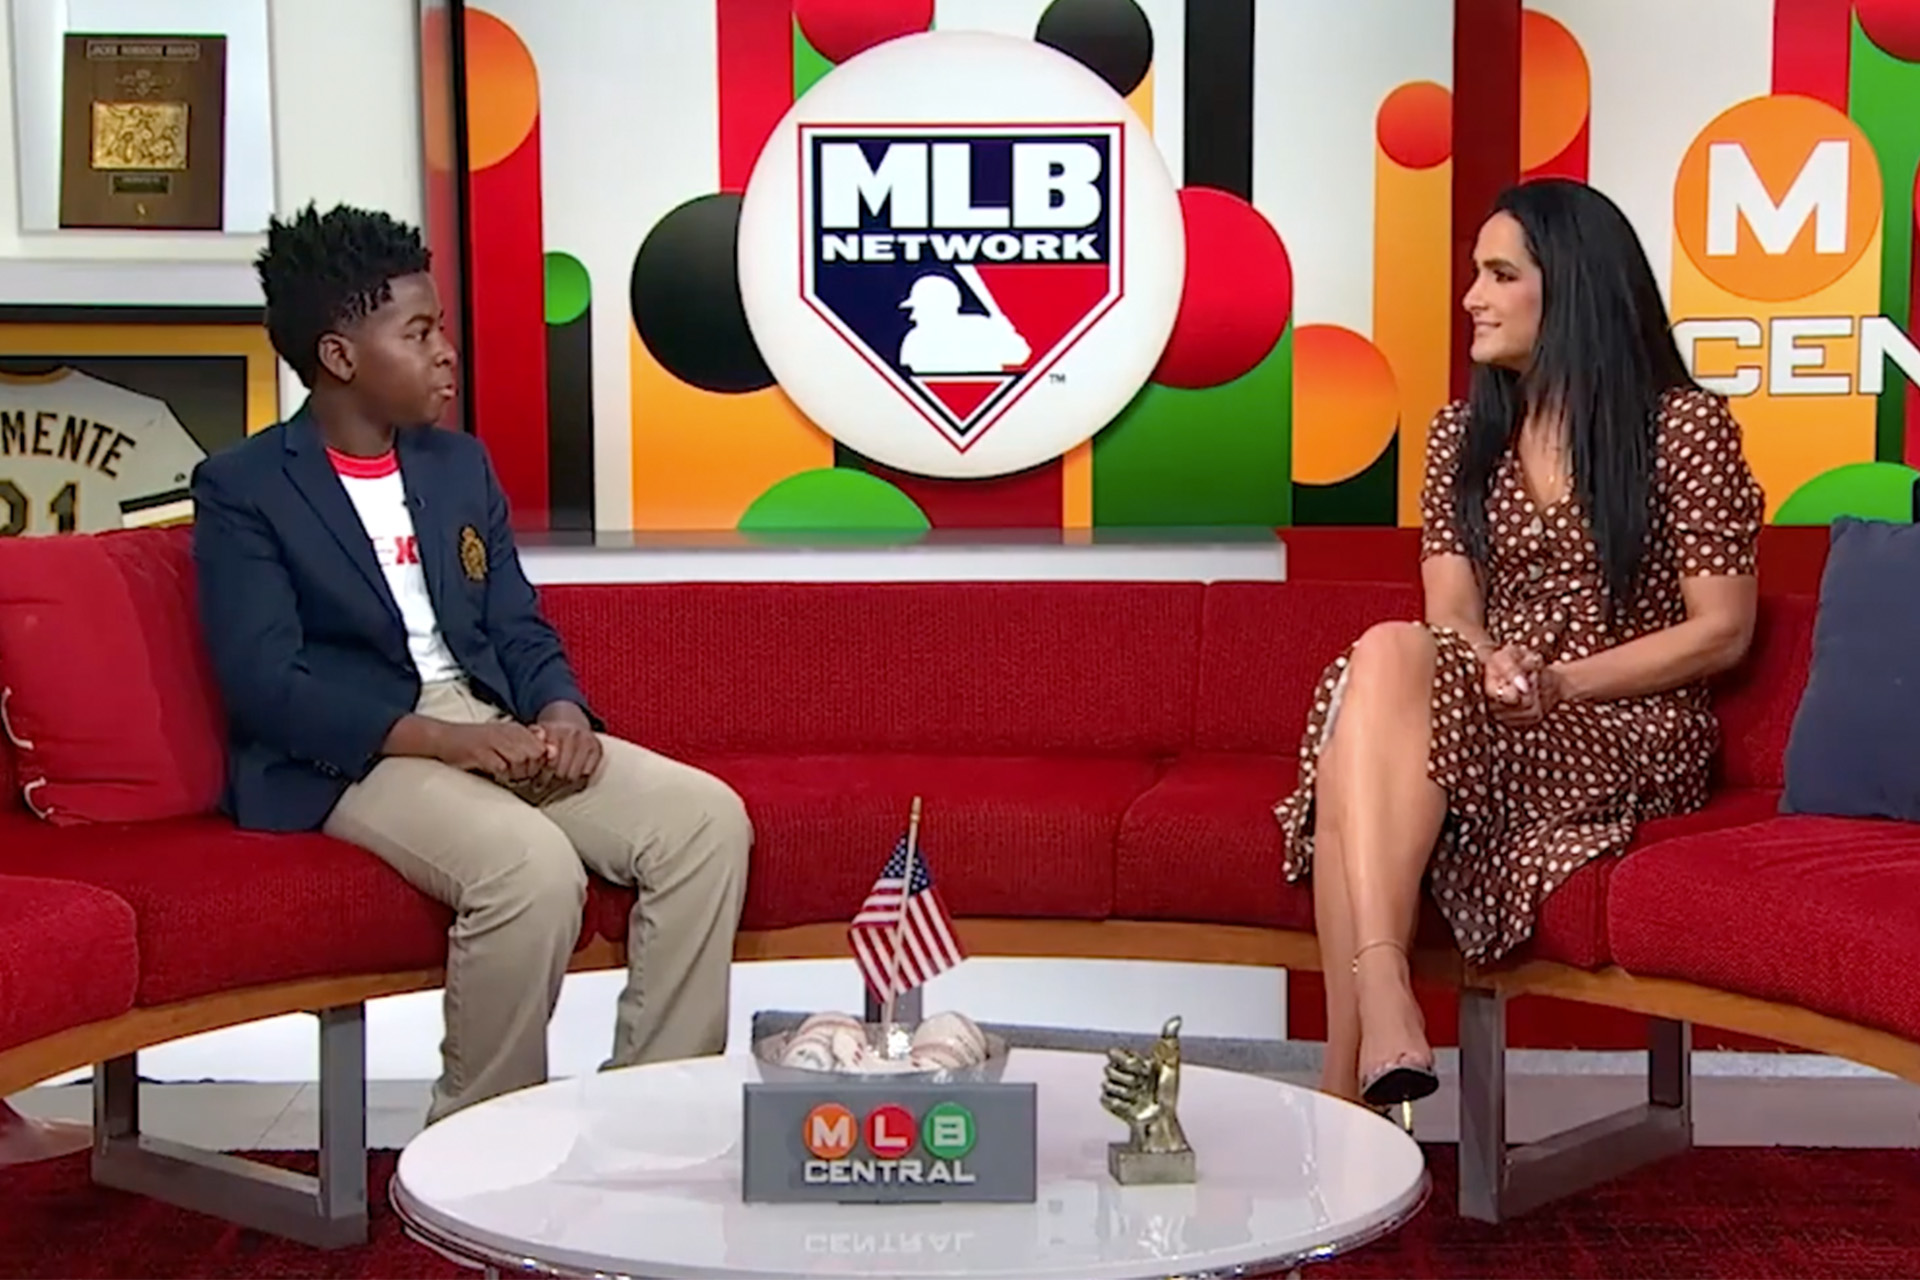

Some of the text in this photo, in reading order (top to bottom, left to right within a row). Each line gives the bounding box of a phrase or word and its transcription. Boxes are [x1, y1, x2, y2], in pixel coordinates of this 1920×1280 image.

[820, 142, 1102, 228] MLB
[1705, 140, 1850, 256] M
[821, 233, 1101, 261] NETWORK
[1049, 374, 1066, 383] TM
[811, 1115, 967, 1147] MLB
[804, 1160, 976, 1183] CENTRAL
